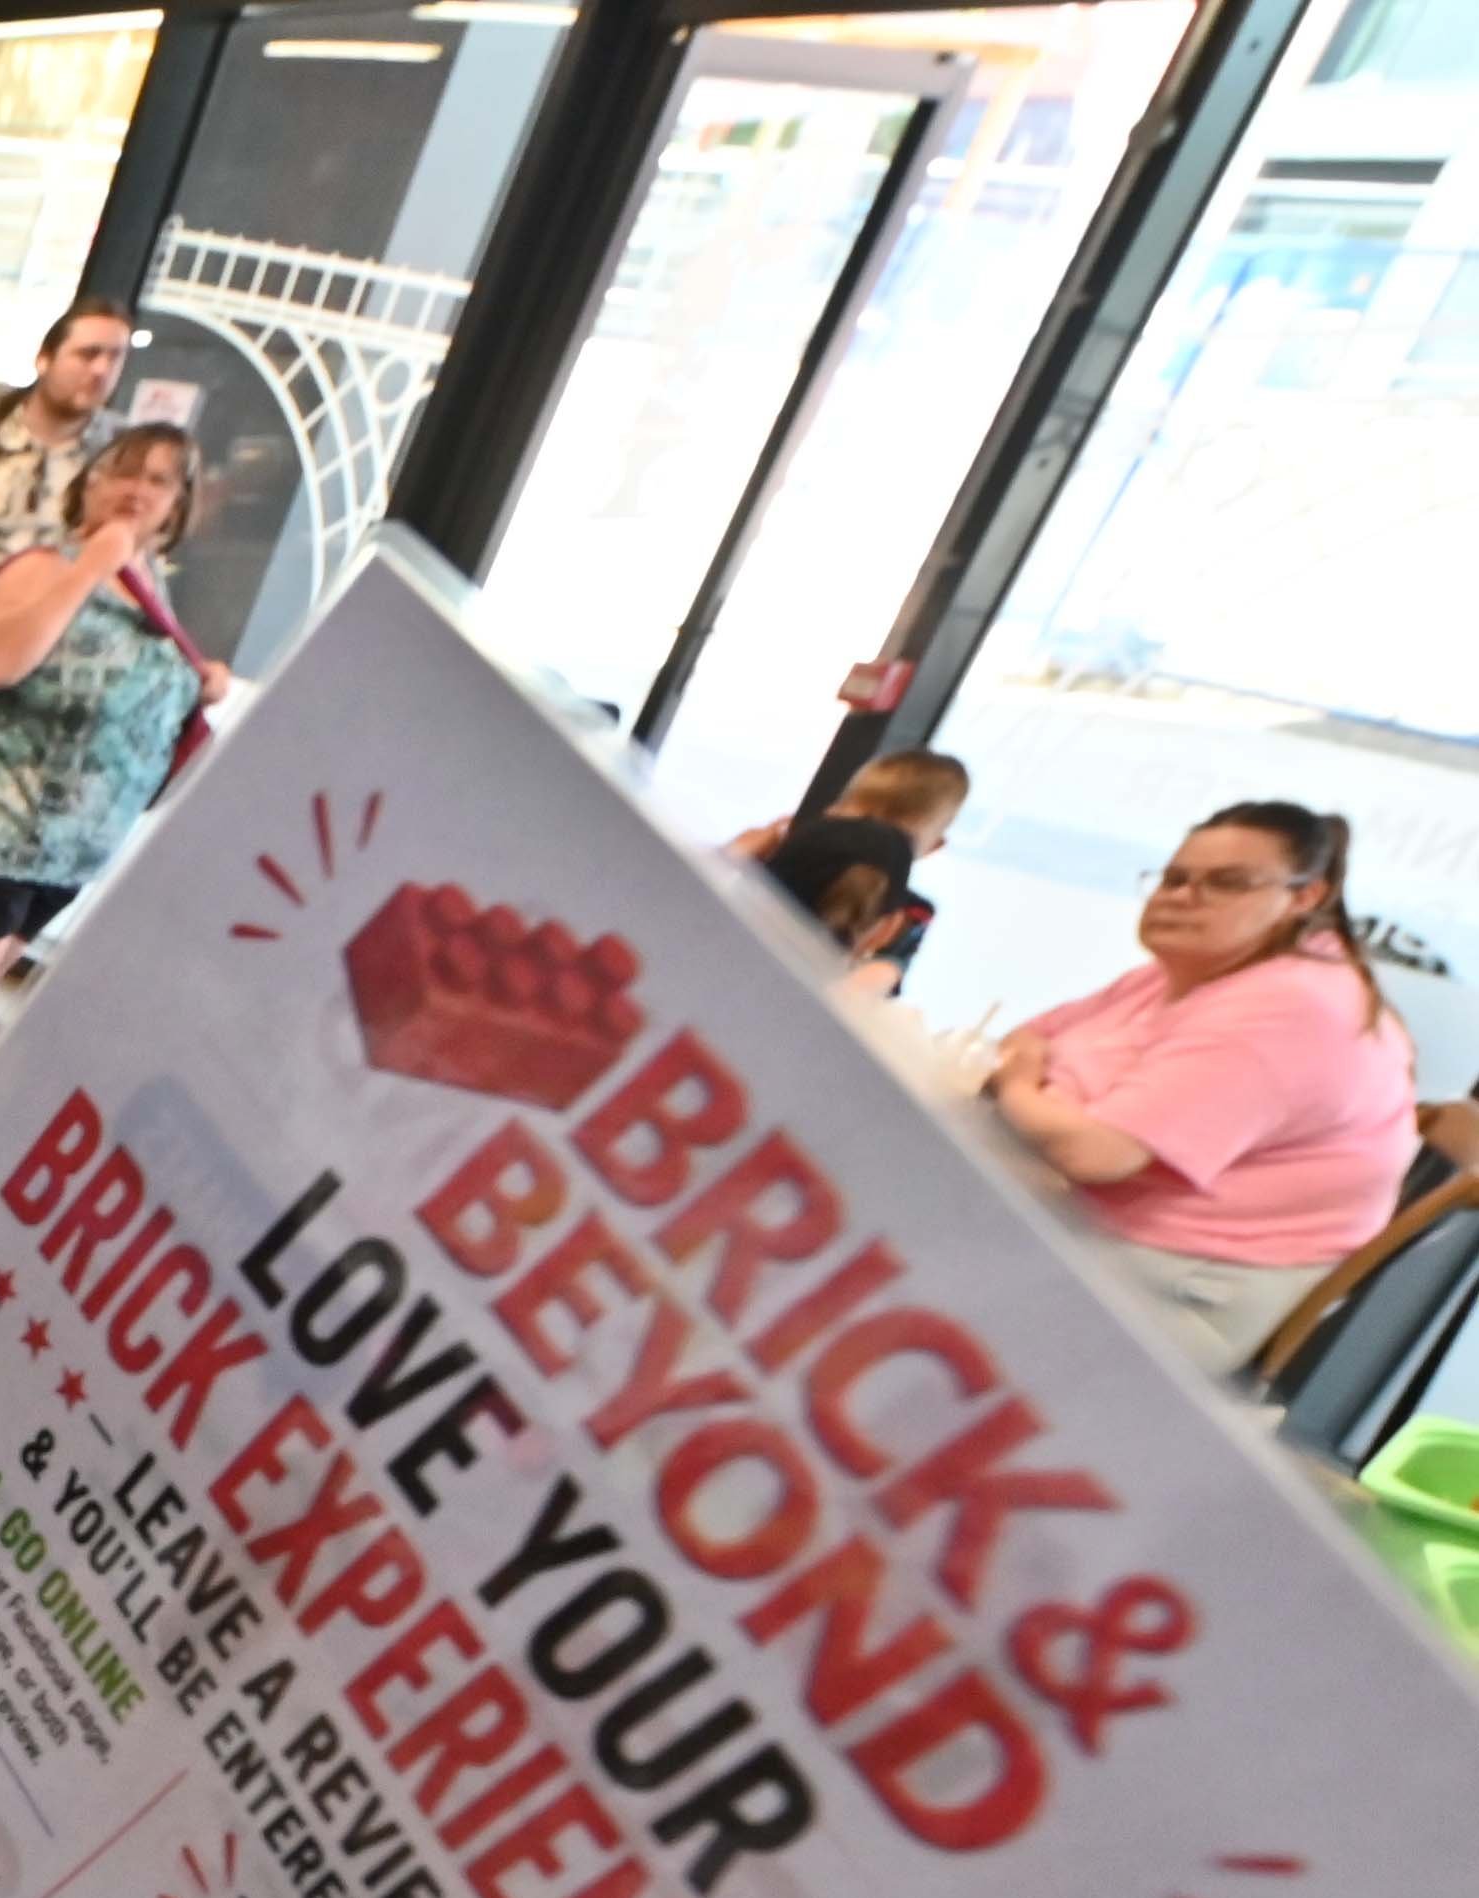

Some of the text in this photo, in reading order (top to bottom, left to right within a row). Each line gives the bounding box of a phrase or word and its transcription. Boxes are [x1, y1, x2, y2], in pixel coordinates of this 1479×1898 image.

[234, 1170, 529, 1518] LOVE
[571, 1027, 1199, 1761] BRICK &
[19, 1428, 56, 1482] &
[53, 1467, 164, 1646] YOU'LL
[155, 1636, 219, 1717] BE
[112, 1451, 263, 1660] LEAVE
[241, 1656, 301, 1724] A
[412, 1118, 1052, 1855] BEYOND
[6, 1592, 76, 1695] Facebook
[66, 1699, 114, 1766] page,
[31, 1690, 72, 1747] both
[36, 1569, 149, 1726] ONLINE
